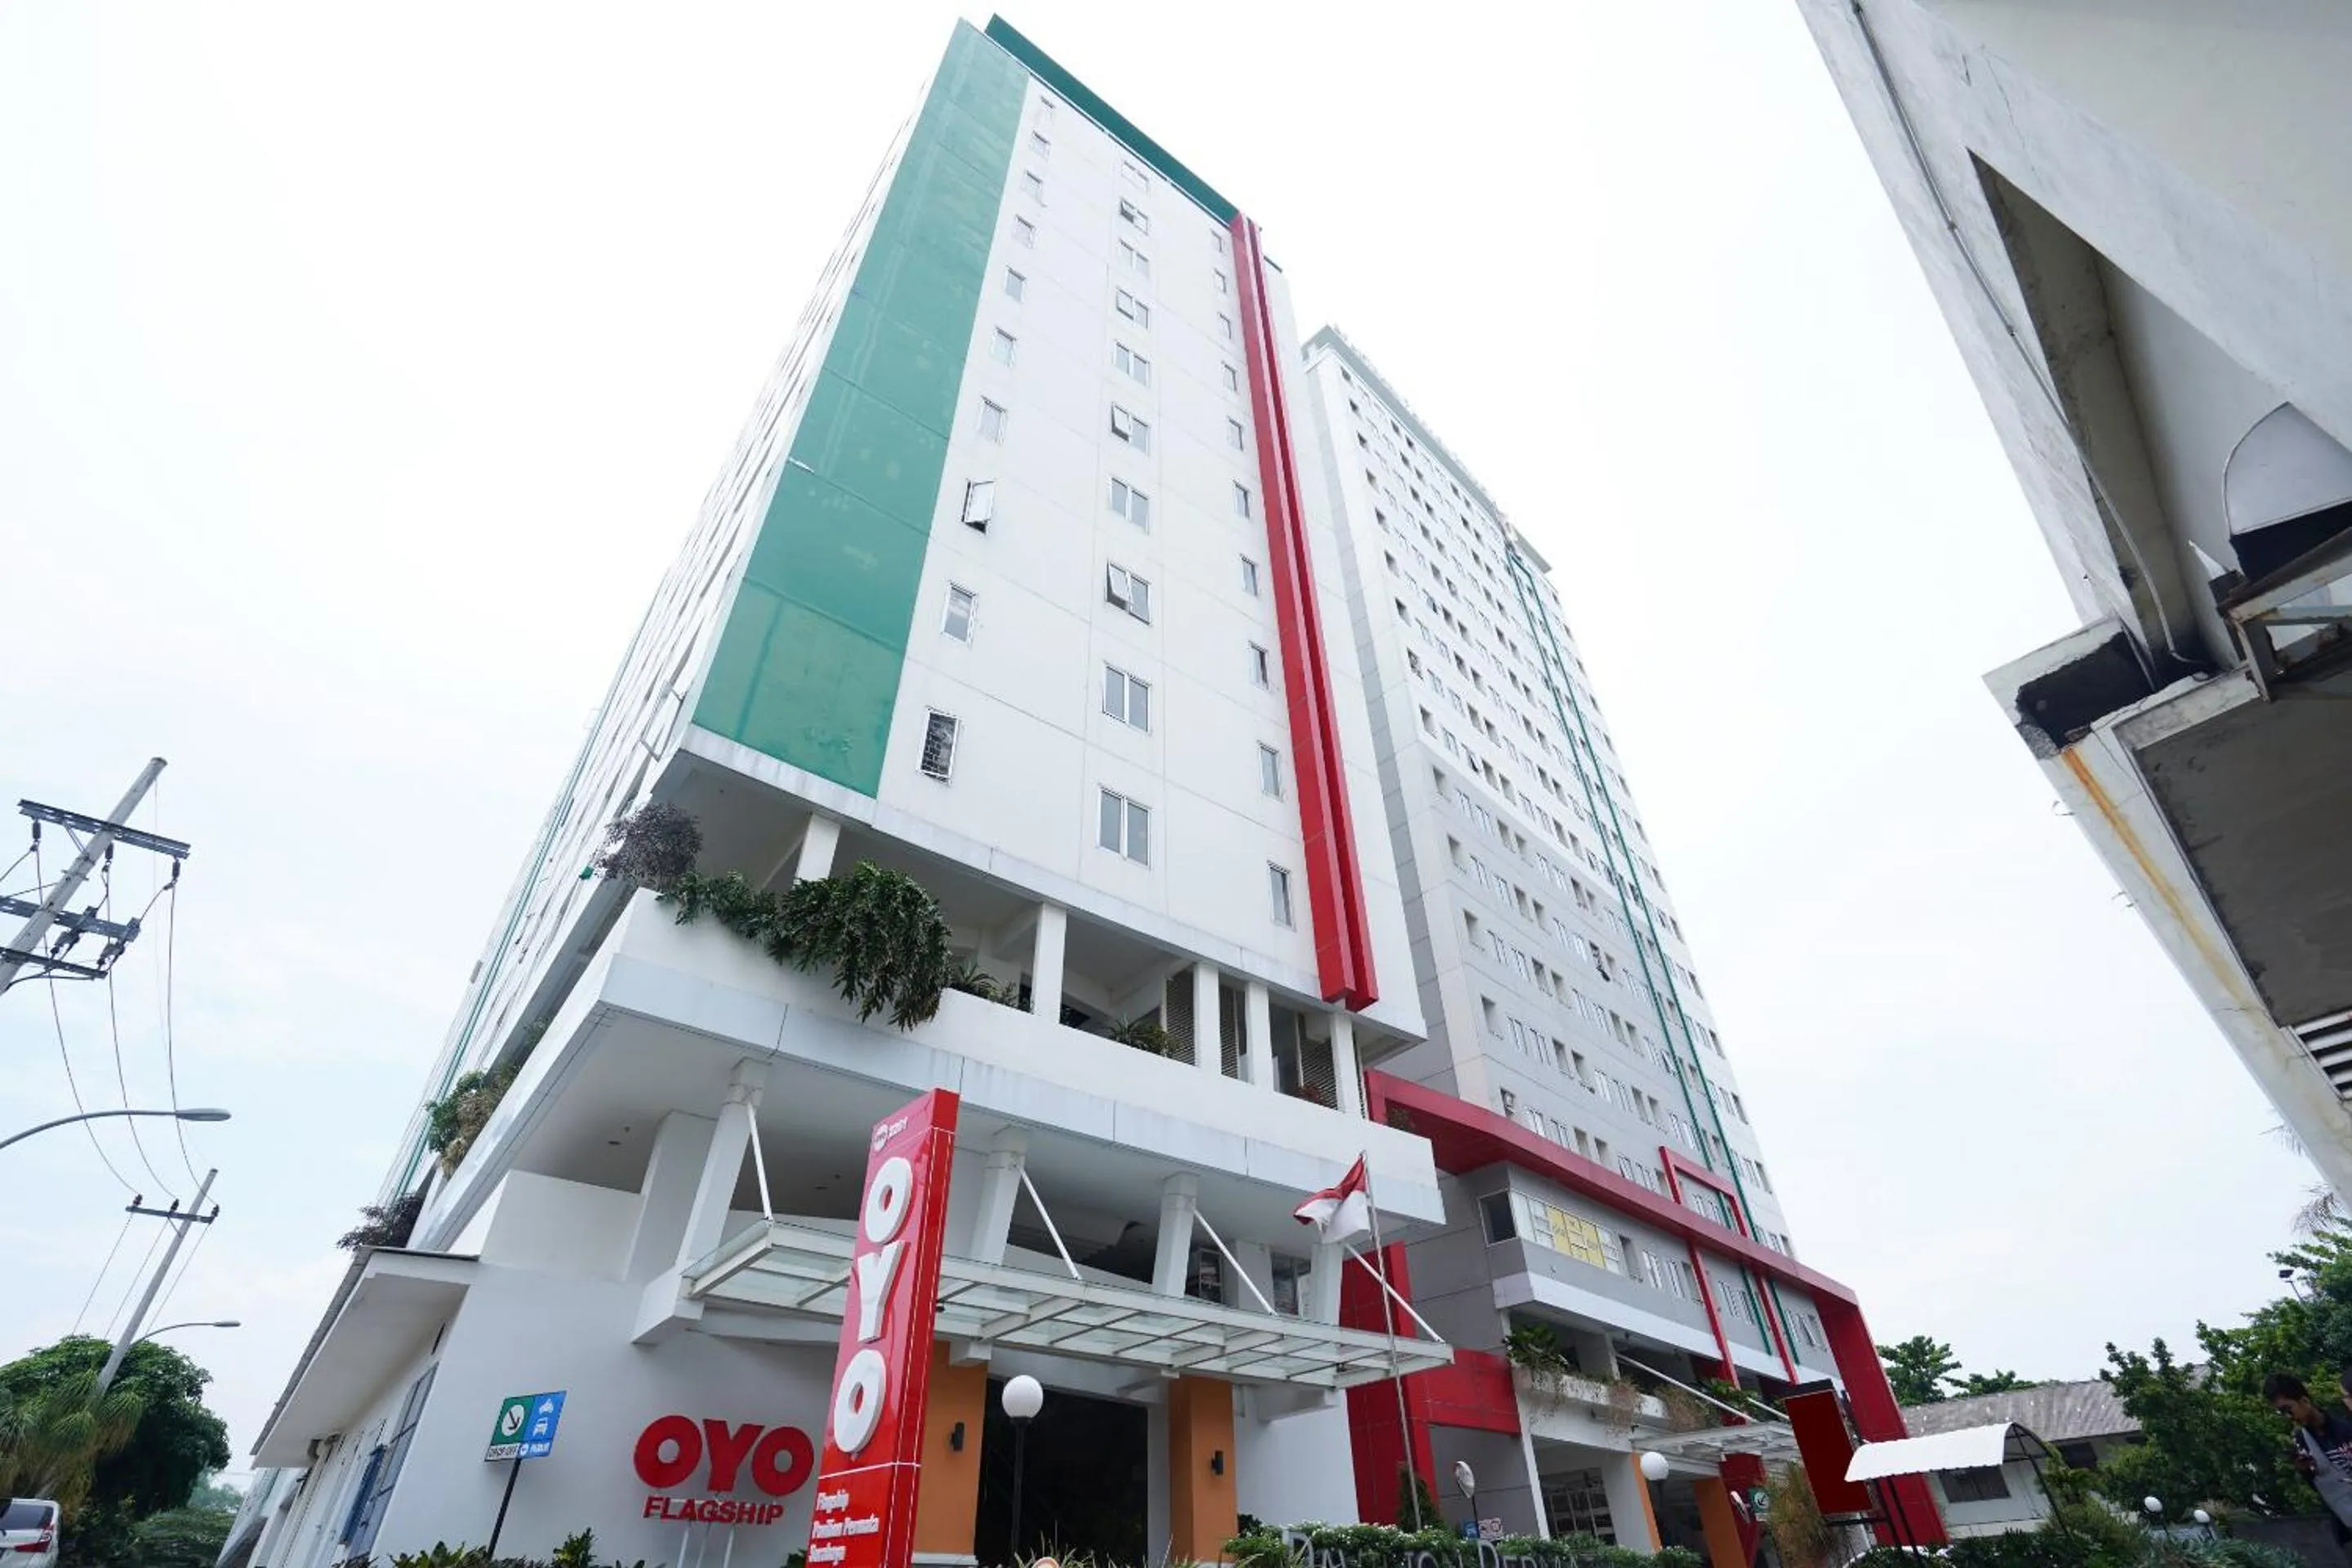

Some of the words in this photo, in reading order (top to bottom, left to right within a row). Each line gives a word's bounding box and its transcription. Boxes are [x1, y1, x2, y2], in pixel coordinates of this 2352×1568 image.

[834, 1156, 912, 1453] OYO
[634, 1415, 814, 1496] OYO
[643, 1496, 784, 1526] FLAGSHIP
